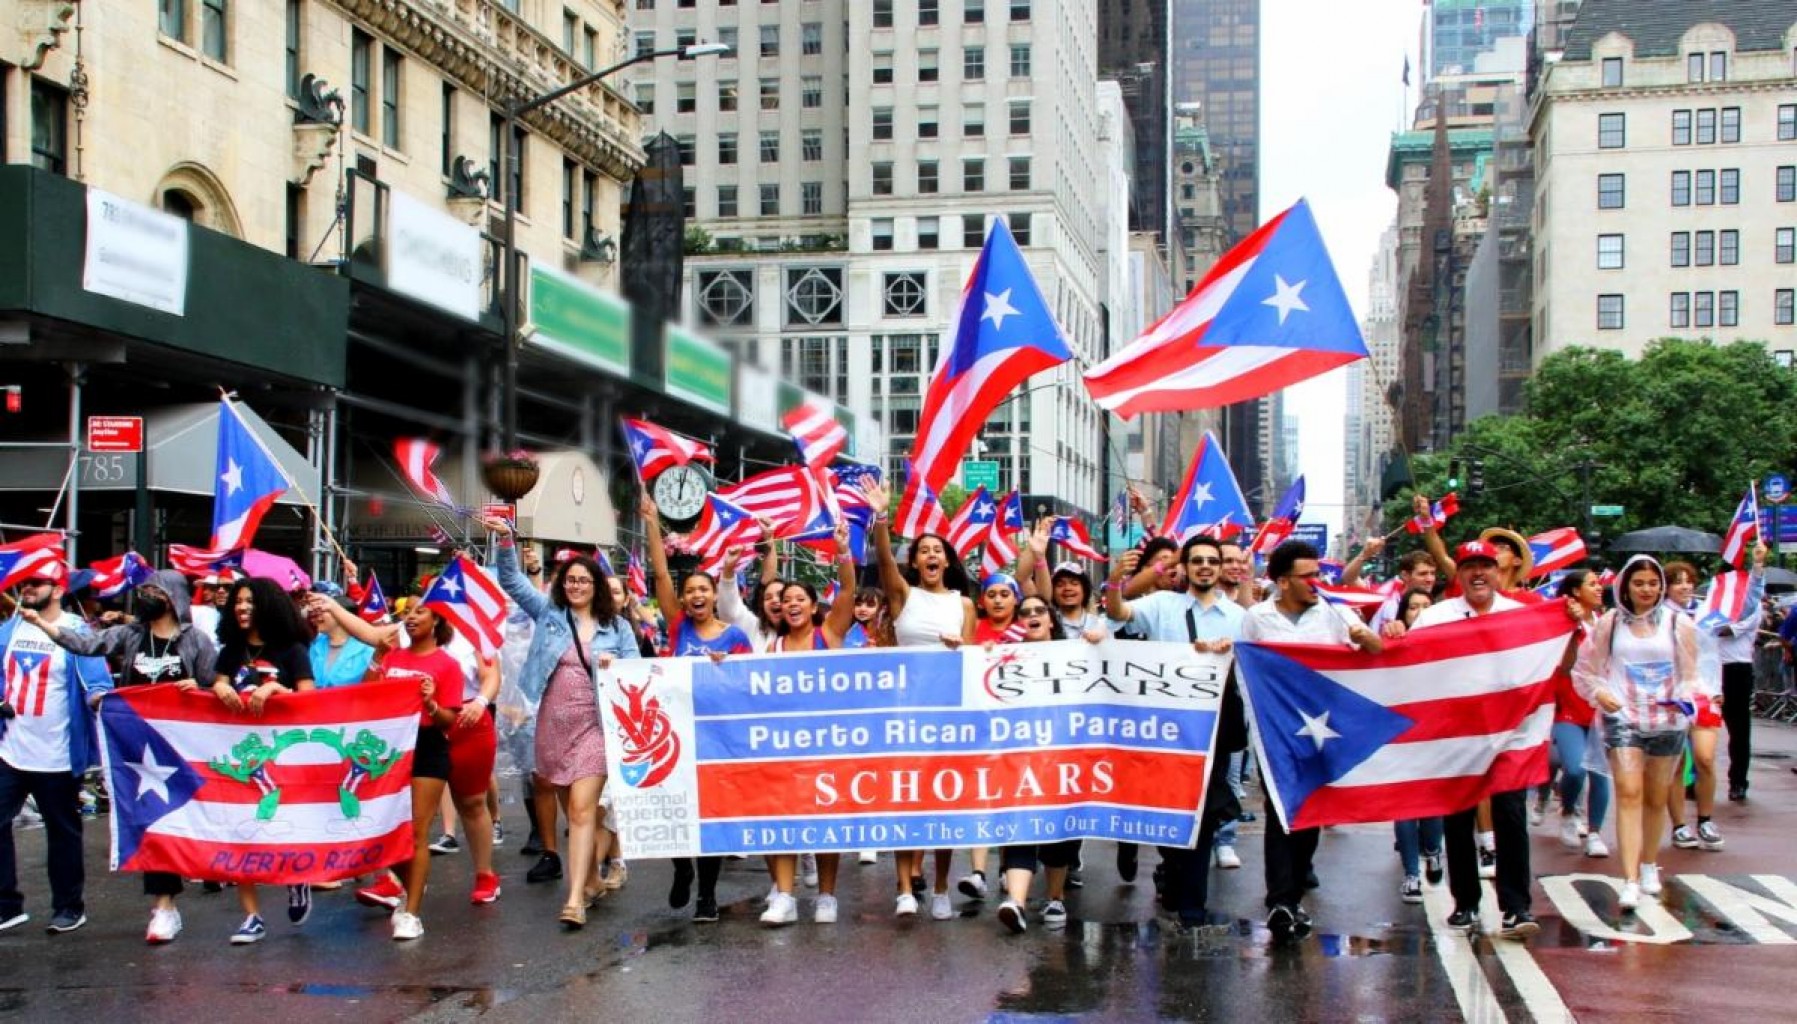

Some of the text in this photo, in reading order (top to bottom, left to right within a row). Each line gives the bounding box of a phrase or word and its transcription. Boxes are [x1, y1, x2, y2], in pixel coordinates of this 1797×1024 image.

[79, 454, 124, 482] 785
[750, 664, 906, 697] National
[997, 659, 1218, 682] RISING
[996, 677, 1220, 700] STARS
[749, 712, 1180, 751] Puerto Rican Day Parade
[814, 761, 1115, 806] SCHOLARS
[977, 820, 1018, 841] Key
[1030, 818, 1055, 836] To
[1064, 816, 1098, 832] Our
[1110, 816, 1180, 839] Future
[210, 843, 385, 874] PUERTO RICO
